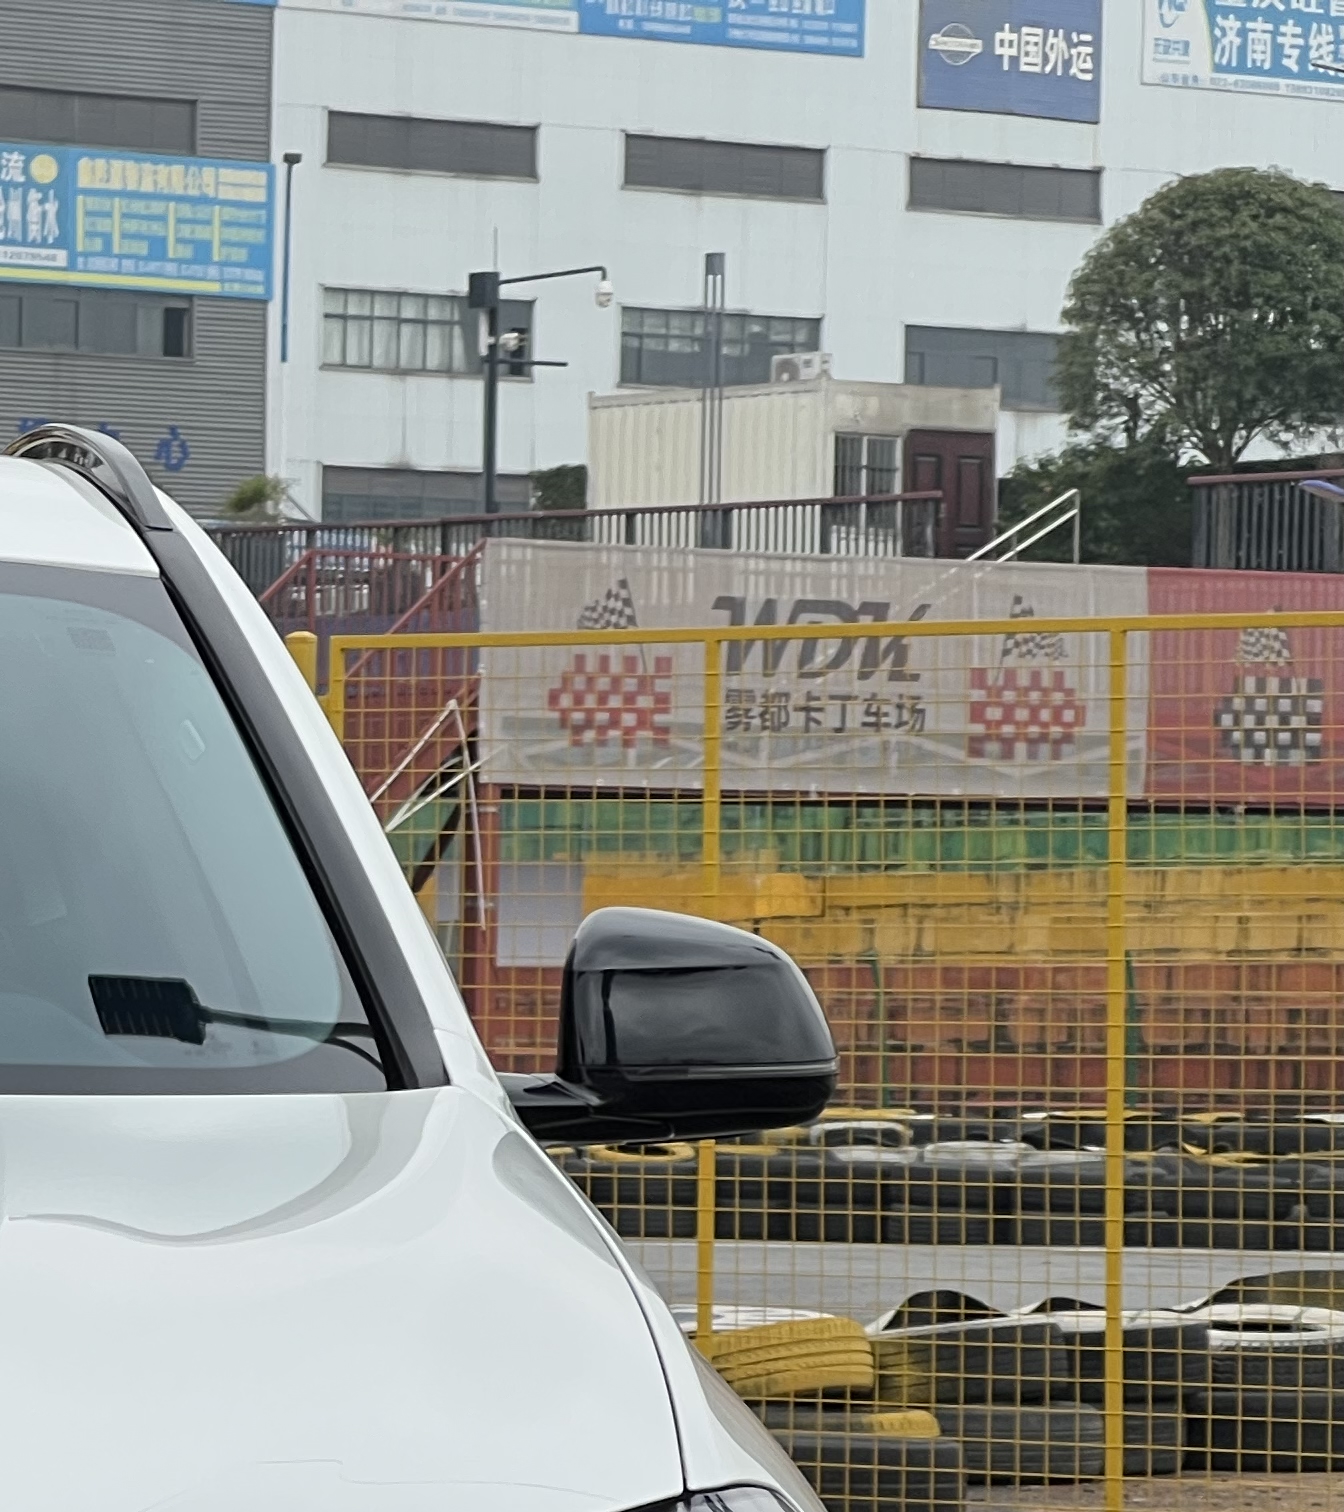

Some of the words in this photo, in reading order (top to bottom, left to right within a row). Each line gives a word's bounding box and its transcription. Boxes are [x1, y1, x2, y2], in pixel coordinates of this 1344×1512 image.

[994, 23, 1094, 81] 中国外运
[1214, 14, 1344, 77] 济南专线
[712, 596, 932, 682] WDK
[724, 688, 927, 734] 雾都卡丁车场
